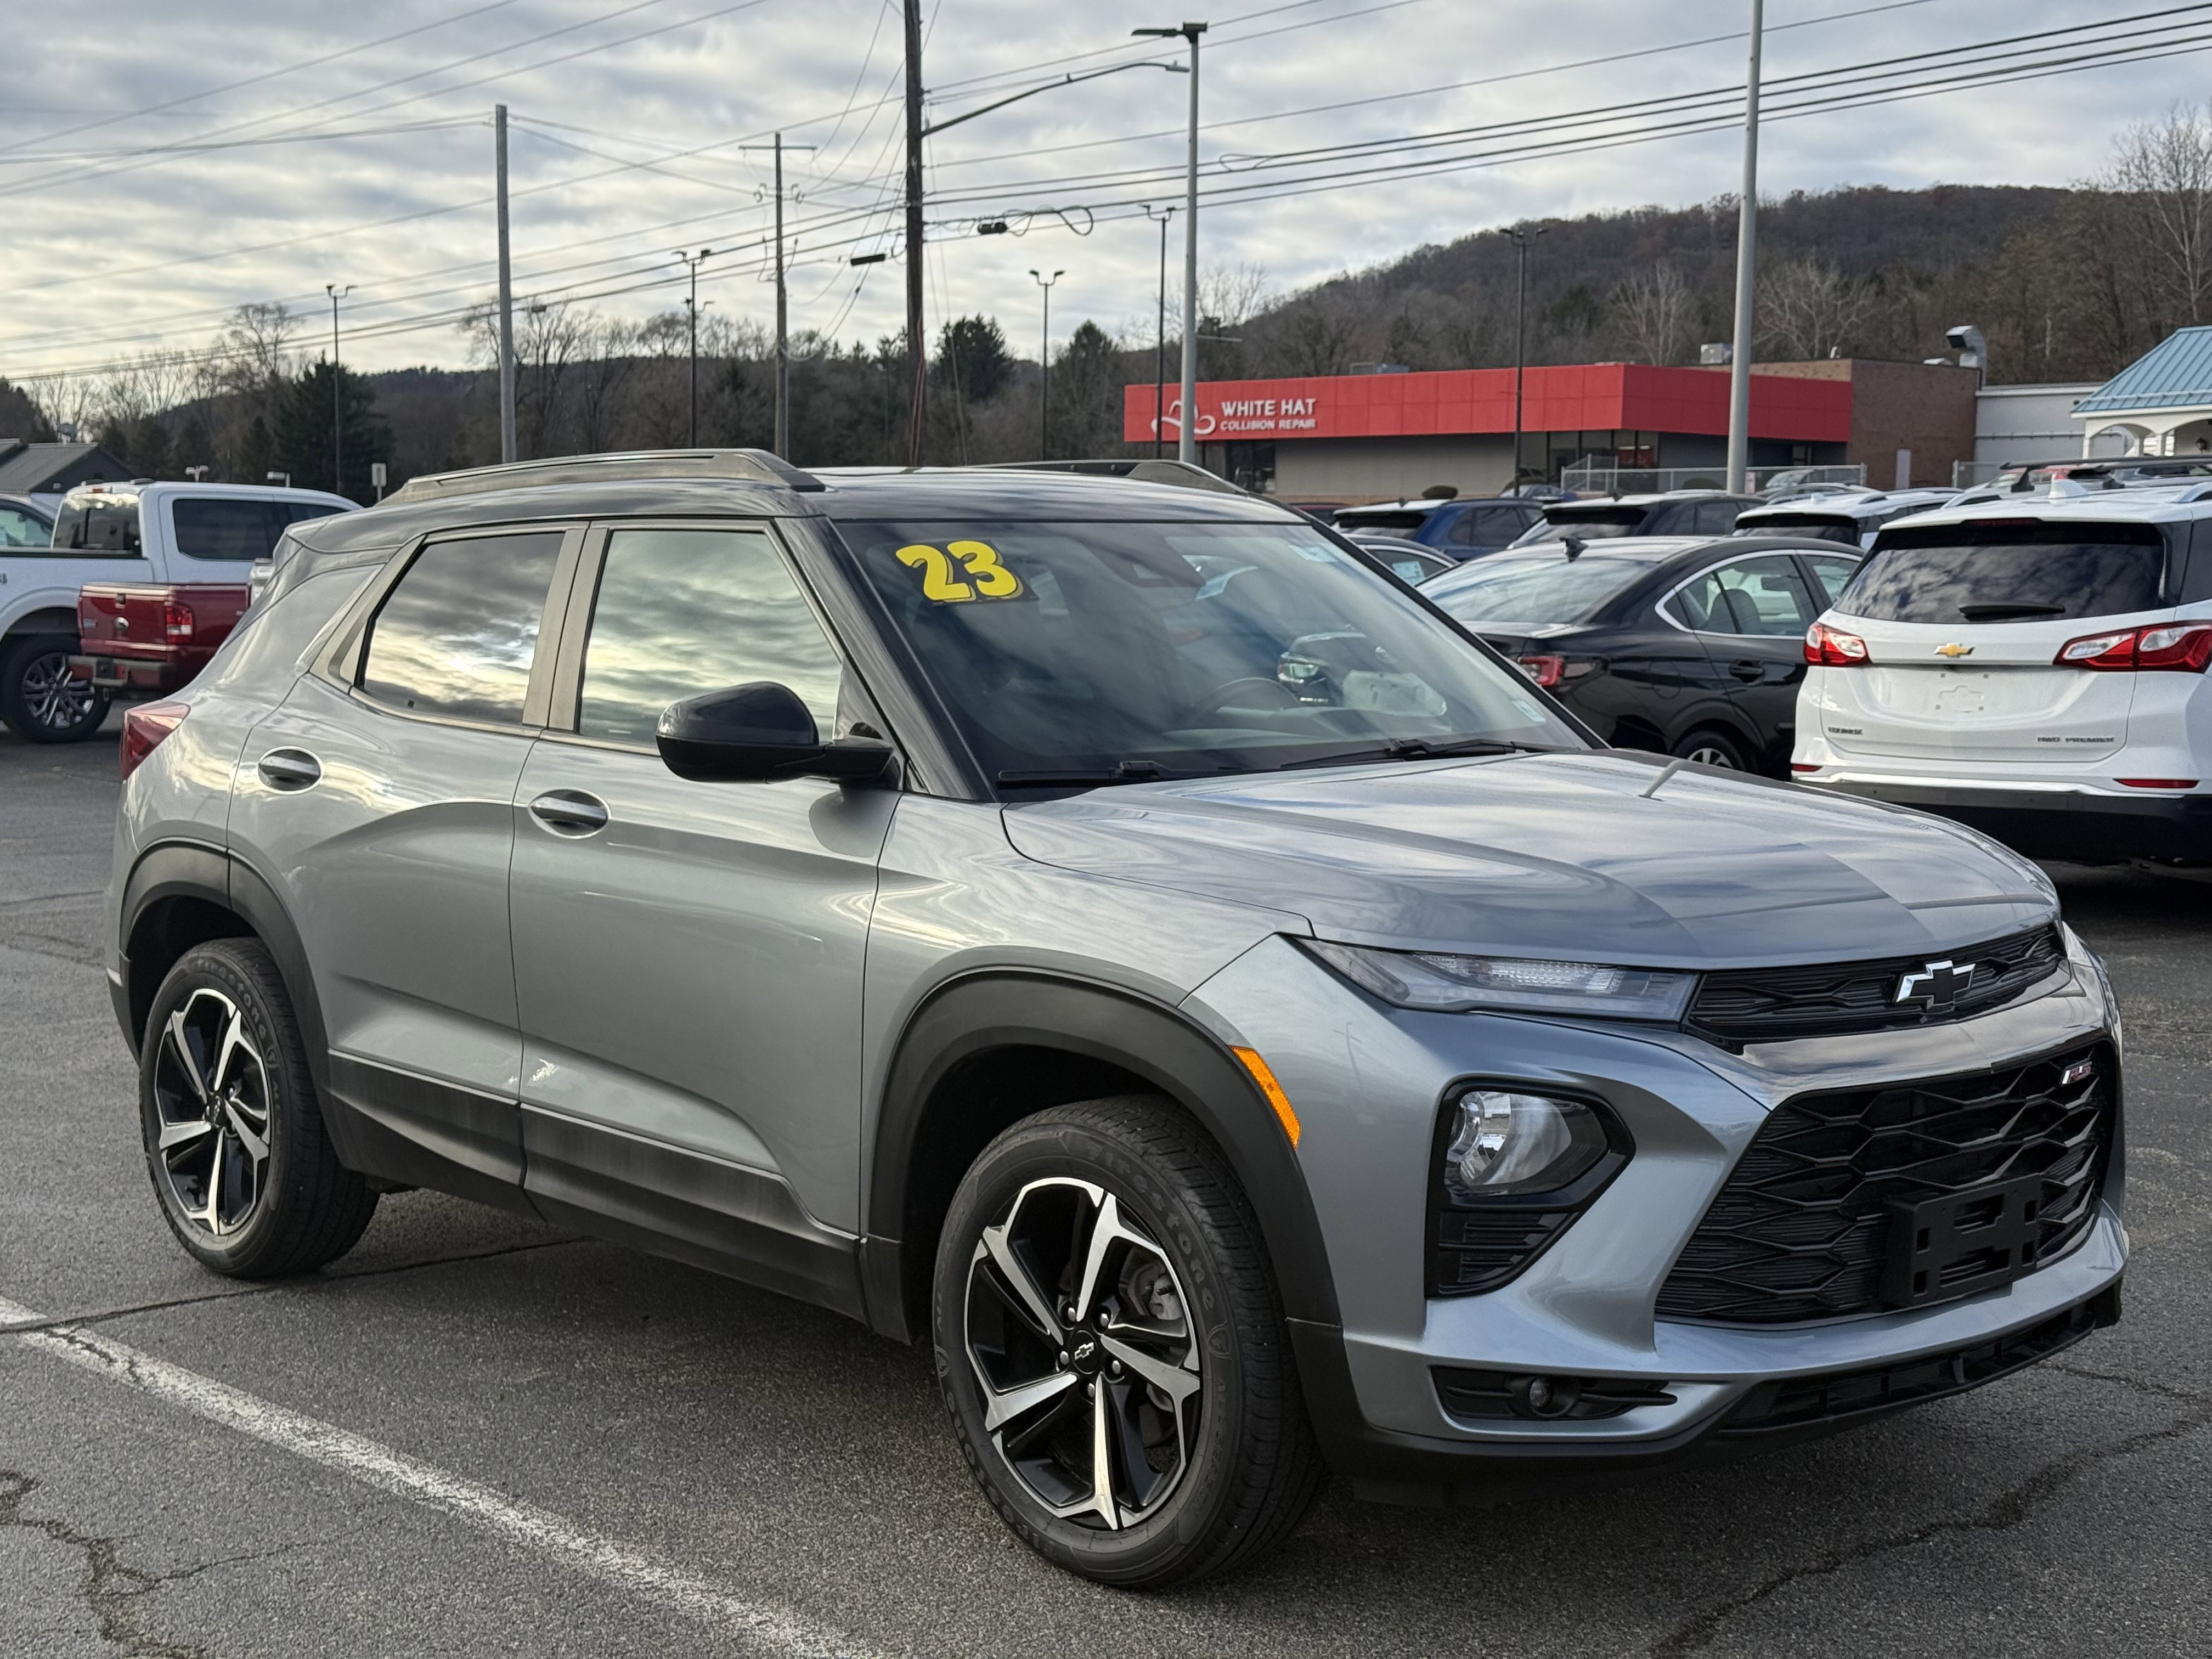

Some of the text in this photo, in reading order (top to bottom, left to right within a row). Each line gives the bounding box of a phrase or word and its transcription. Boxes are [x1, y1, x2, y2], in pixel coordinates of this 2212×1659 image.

[1220, 419, 1316, 431] COLLISION REPAIR
[1221, 398, 1317, 417] WHITE HAT
[895, 540, 1024, 602] 23
[1086, 1143, 1215, 1311] Firestone
